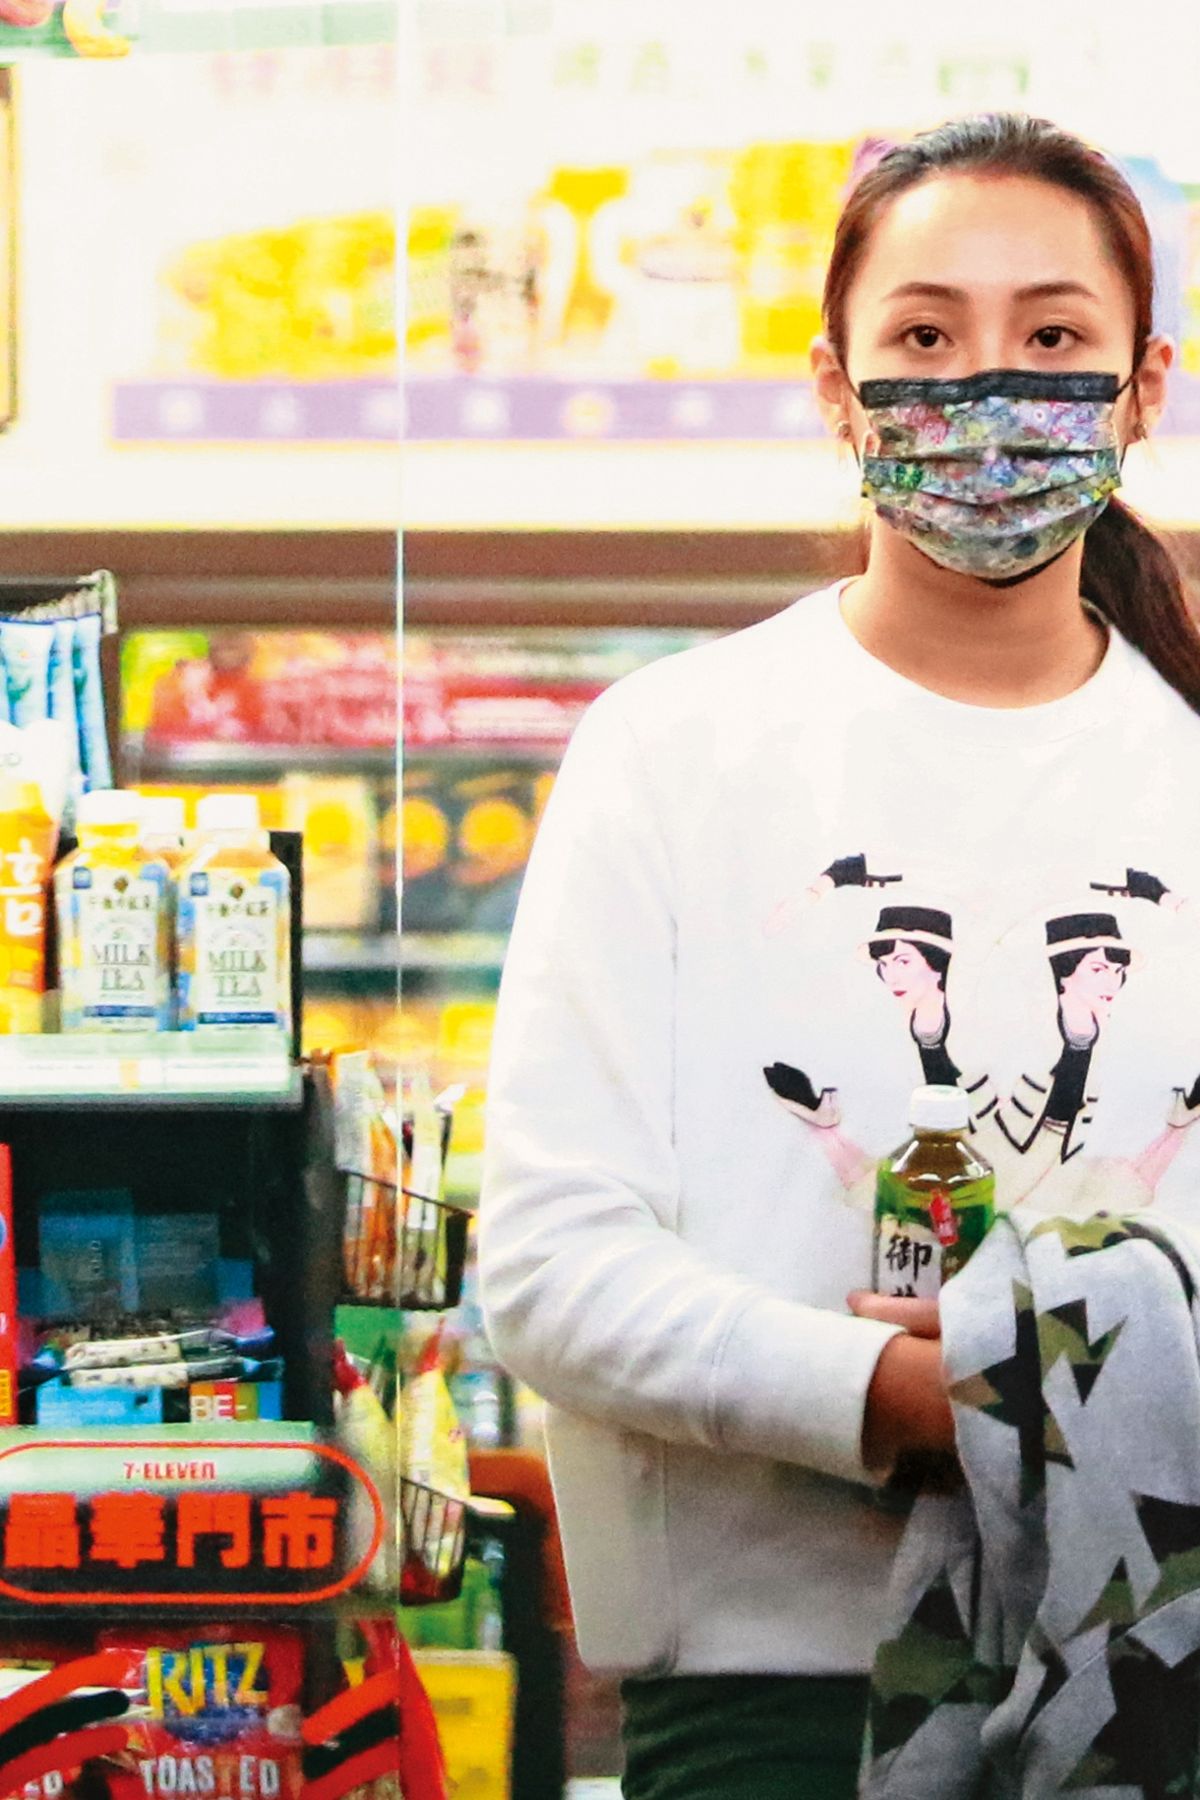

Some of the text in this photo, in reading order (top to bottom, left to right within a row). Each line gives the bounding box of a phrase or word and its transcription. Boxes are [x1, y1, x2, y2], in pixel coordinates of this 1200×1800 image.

[93, 944, 150, 965] MILK
[208, 950, 267, 972] MILK
[101, 969, 145, 991] TEA
[213, 974, 262, 997] TEA
[146, 1642, 268, 1720] RITZ
[139, 1754, 280, 1798] TOASTED
